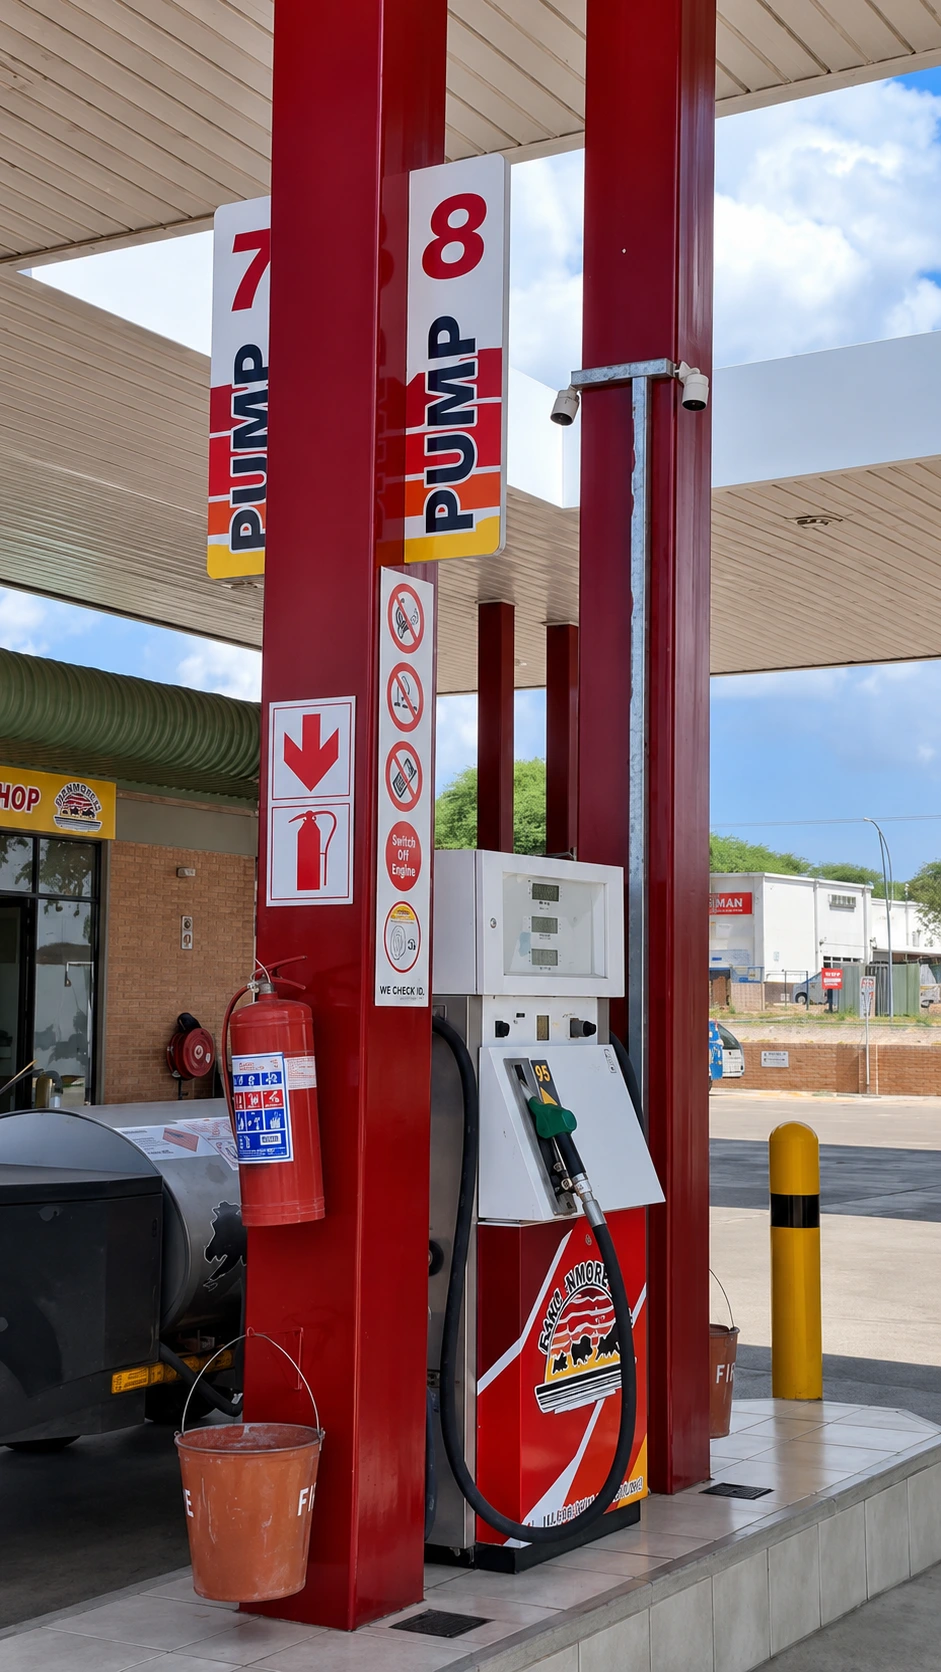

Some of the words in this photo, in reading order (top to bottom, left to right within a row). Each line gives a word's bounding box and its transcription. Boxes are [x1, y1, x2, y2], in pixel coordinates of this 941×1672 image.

[422, 193, 487, 280] 8
[231, 228, 271, 312] 7
[425, 316, 477, 533] PUMP
[231, 345, 269, 551] PUMP
[392, 834, 416, 848] Switch
[397, 849, 409, 861] Off
[391, 863, 416, 879] Engine
[379, 985, 391, 995] WE
[392, 986, 416, 996] CHECK
[534, 1064, 551, 1082] 95
[184, 1488, 194, 1518] E
